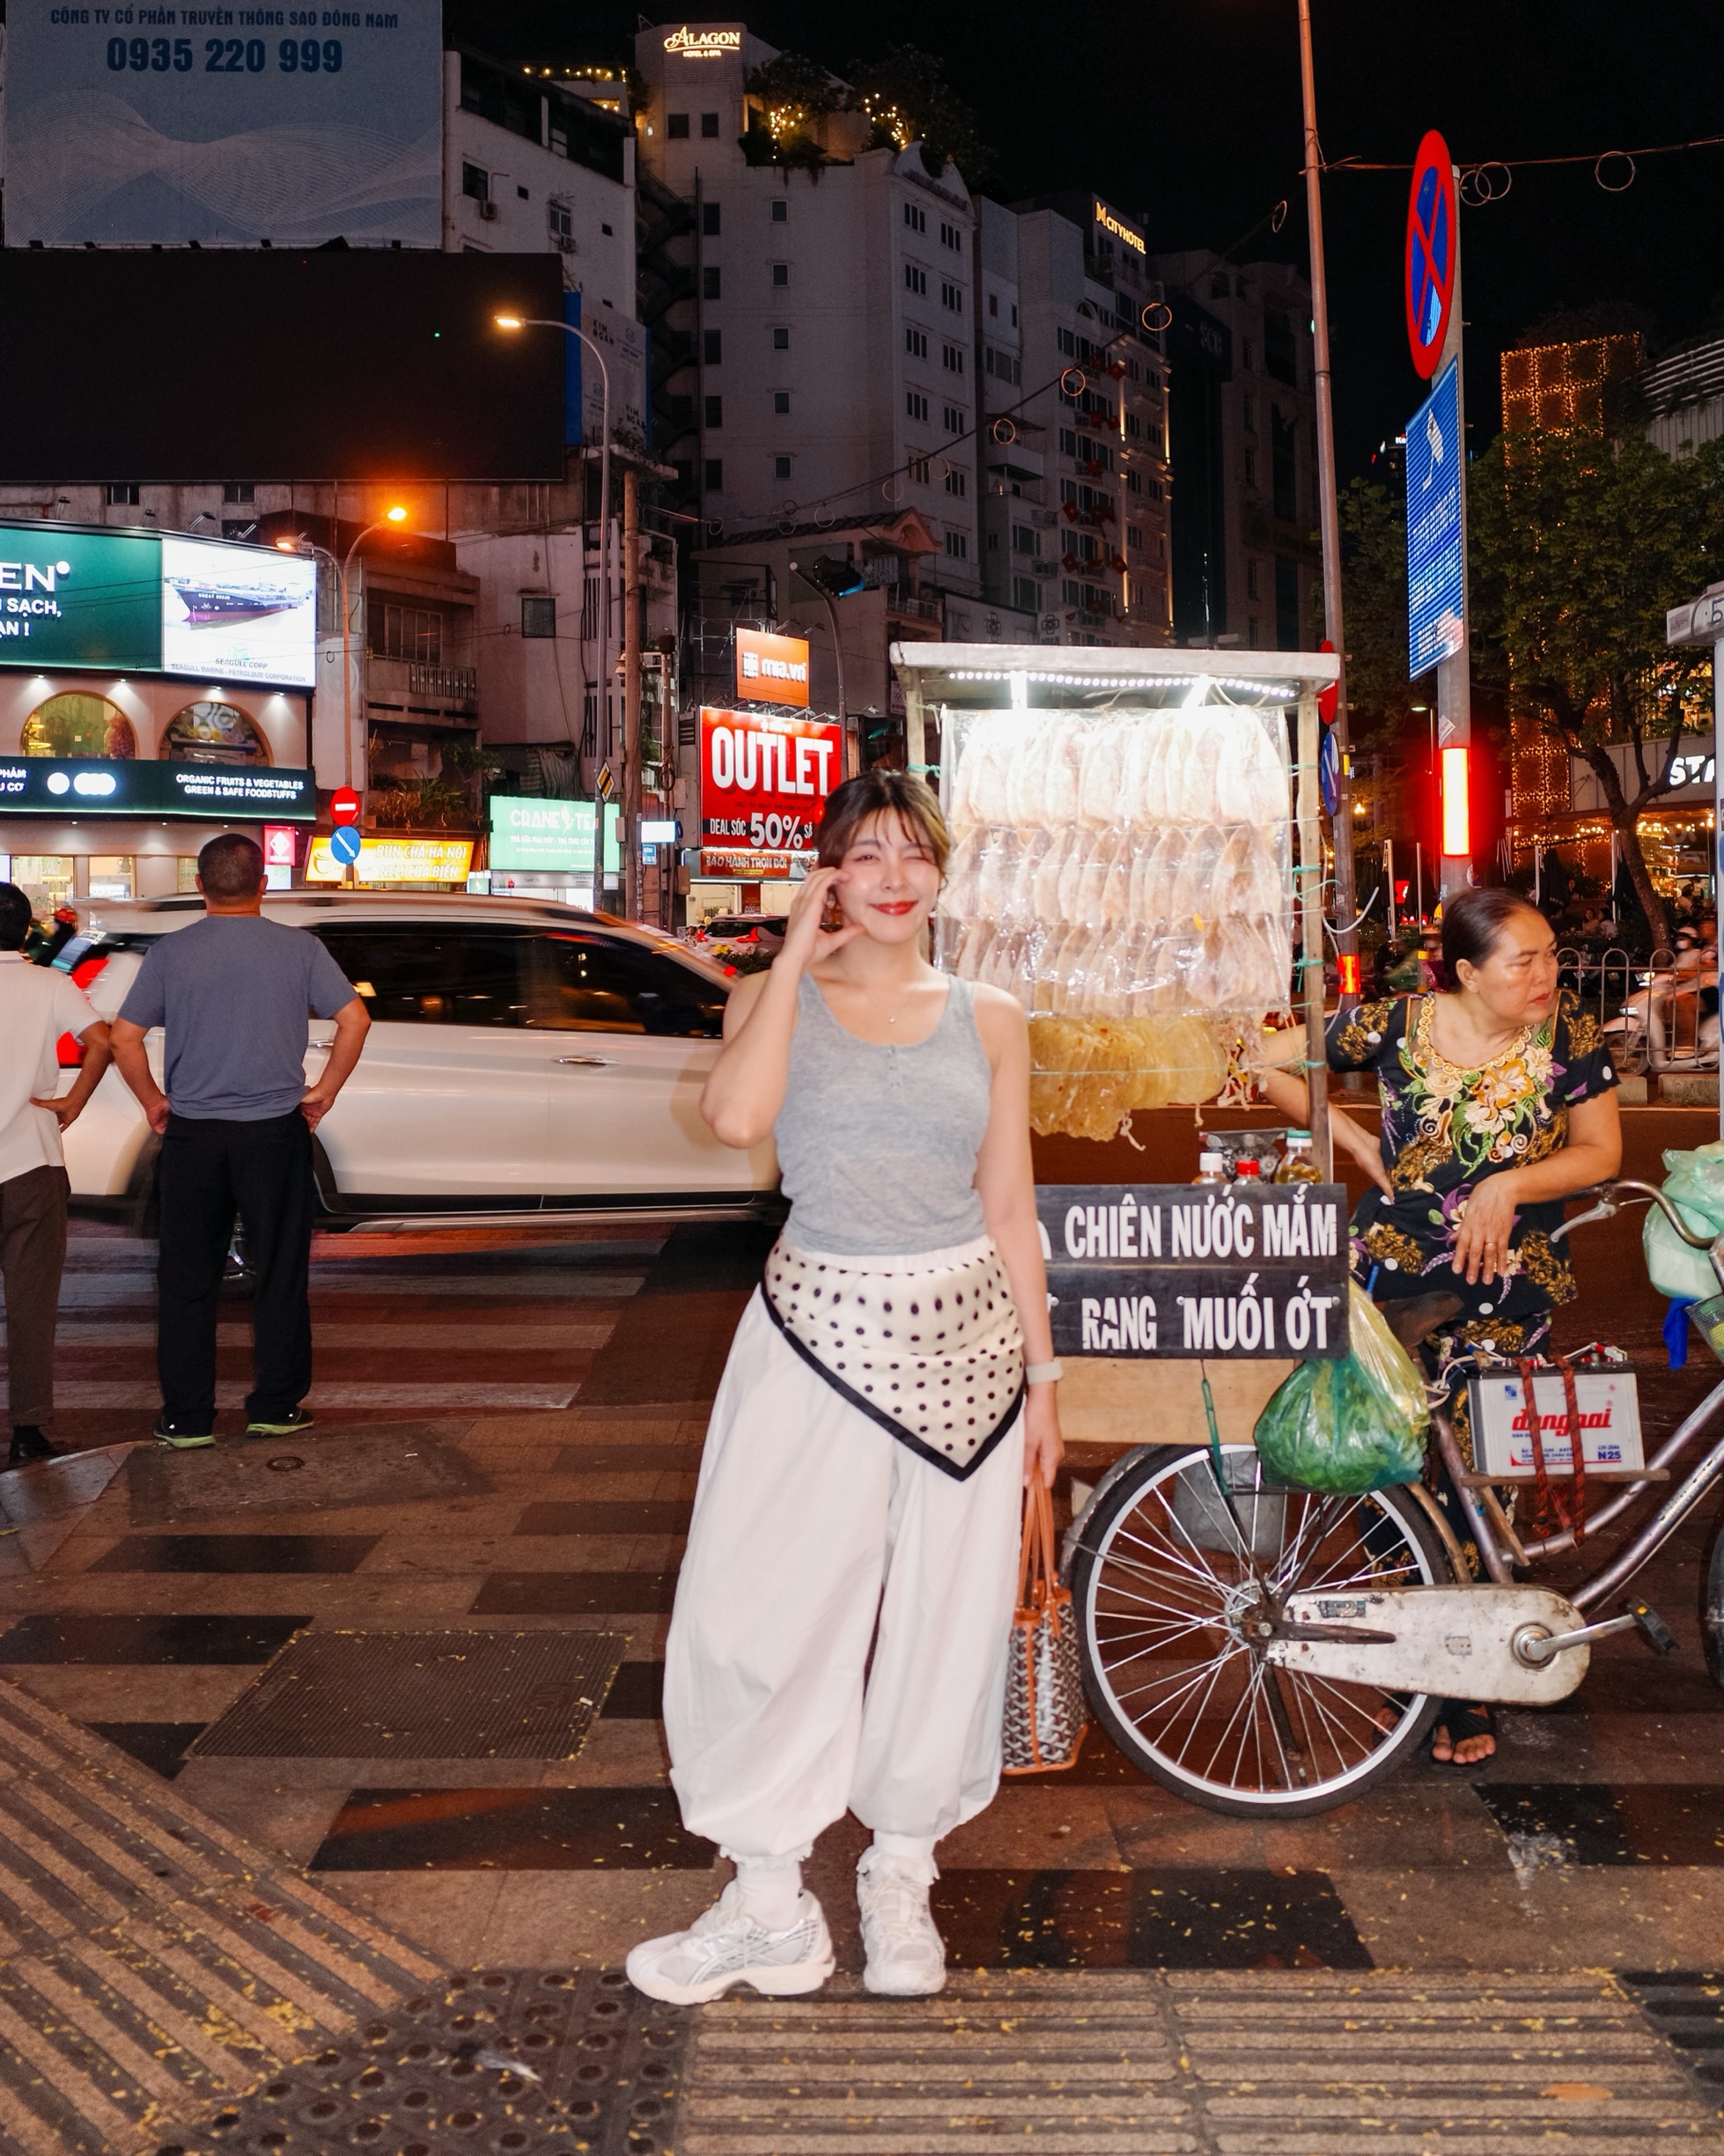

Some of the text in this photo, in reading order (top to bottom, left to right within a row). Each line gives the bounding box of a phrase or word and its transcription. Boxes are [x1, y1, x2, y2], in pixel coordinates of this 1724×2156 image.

[51, 4, 398, 28] CÔNG TY CỔ PHẦN TRUYỀN THÔNG SAO ĐÔNG NAM
[664, 26, 741, 48] ALAGON
[107, 37, 343, 73] 0935 220 999
[593, 319, 608, 332] KIM
[7, 598, 62, 618] SẠCH,
[215, 658, 247, 667] SEAGULL
[229, 669, 263, 678] PETROLEUM
[265, 673, 306, 682] CORPORATION
[711, 726, 834, 797] OUTLET
[176, 774, 304, 790] ORGANIC FRUITS & VEGETABLES
[184, 784, 297, 799] GREEN & SAFE FOODSTUFFS
[511, 808, 561, 829] CRANE
[710, 818, 730, 835] DEAL
[749, 812, 804, 850] 50%
[375, 842, 401, 858] BÚN
[428, 843, 444, 858] HÀ
[446, 845, 468, 861] NỘI
[726, 853, 749, 868] HÀNH
[750, 857, 772, 870] TRỌN
[379, 865, 404, 879] NEM
[406, 865, 429, 879] CUA
[1065, 1193, 1162, 1258] CHIÊN
[1171, 1184, 1255, 1258] NƯỚC
[1263, 1183, 1337, 1257] MẮM
[1082, 1272, 1333, 1350] RANG MUỐI ỚT
[1598, 1450, 1621, 1460] N25
